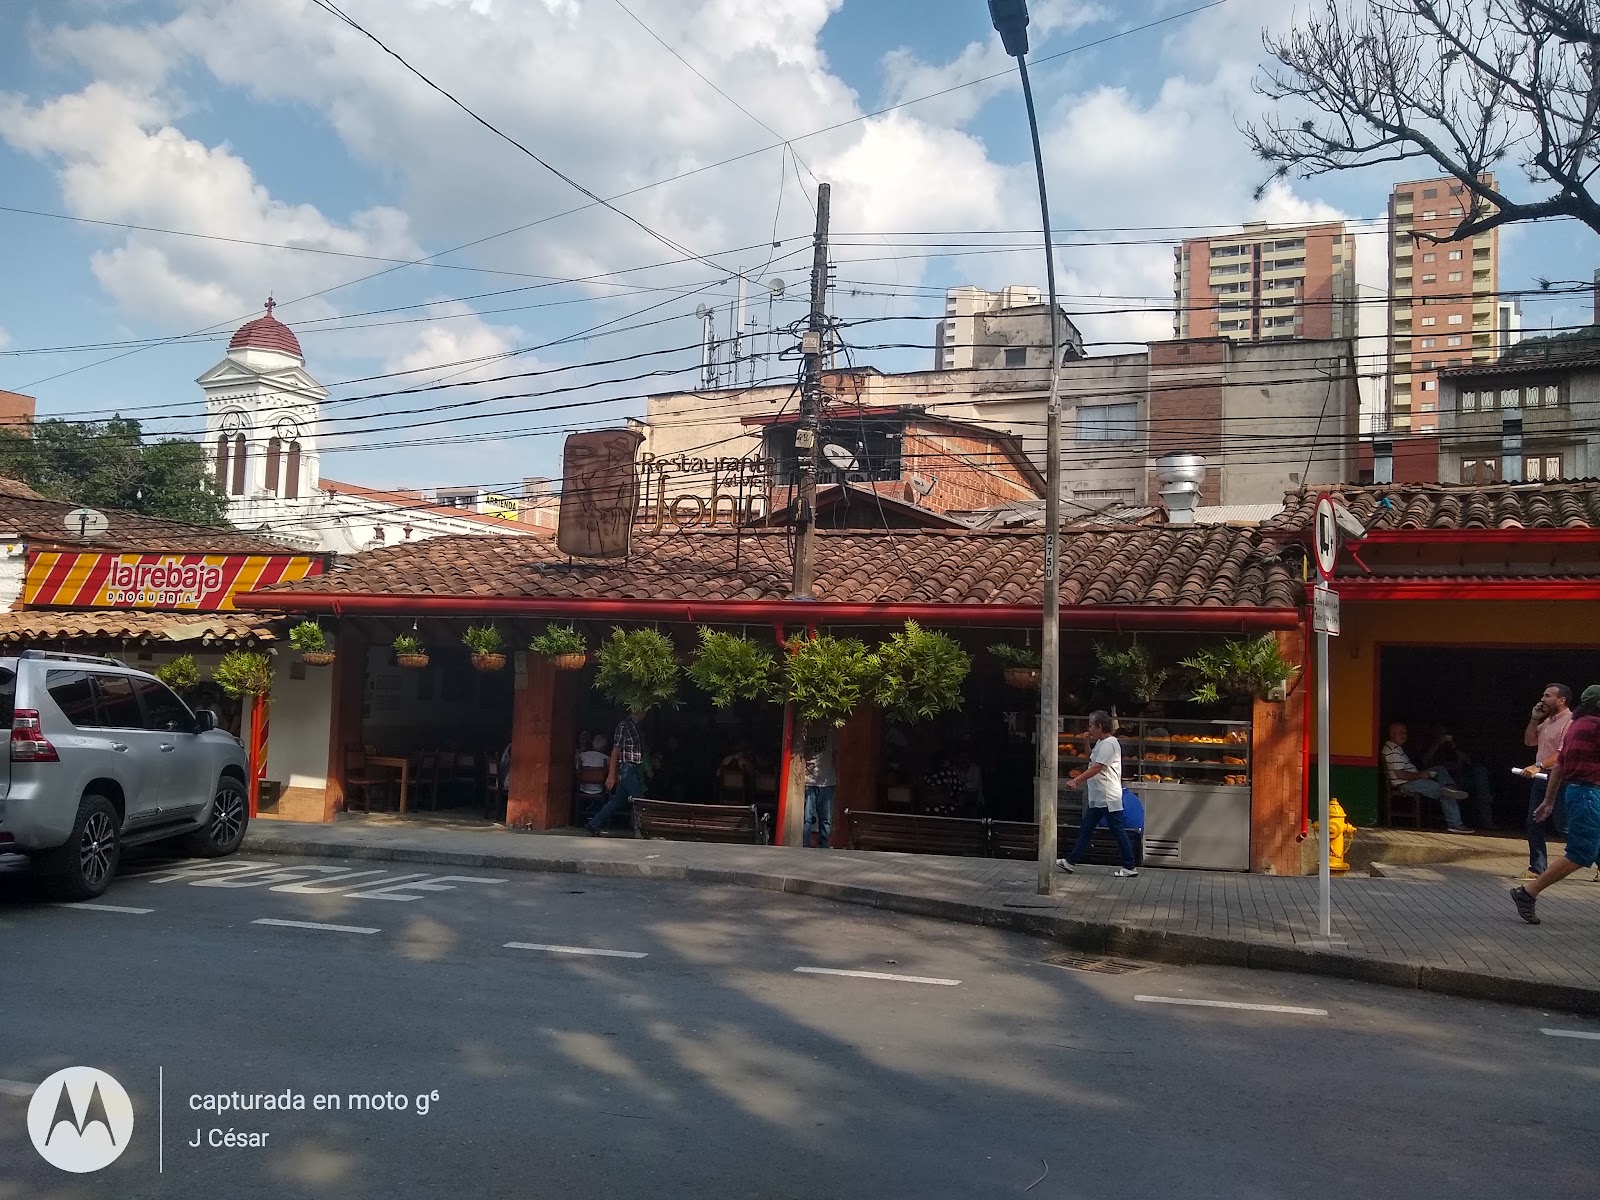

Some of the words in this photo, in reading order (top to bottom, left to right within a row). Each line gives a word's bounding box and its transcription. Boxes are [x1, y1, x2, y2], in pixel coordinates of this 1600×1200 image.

[640, 452, 776, 474] Restaurante
[639, 475, 772, 535] John
[108, 592, 192, 602] DROGUERIA
